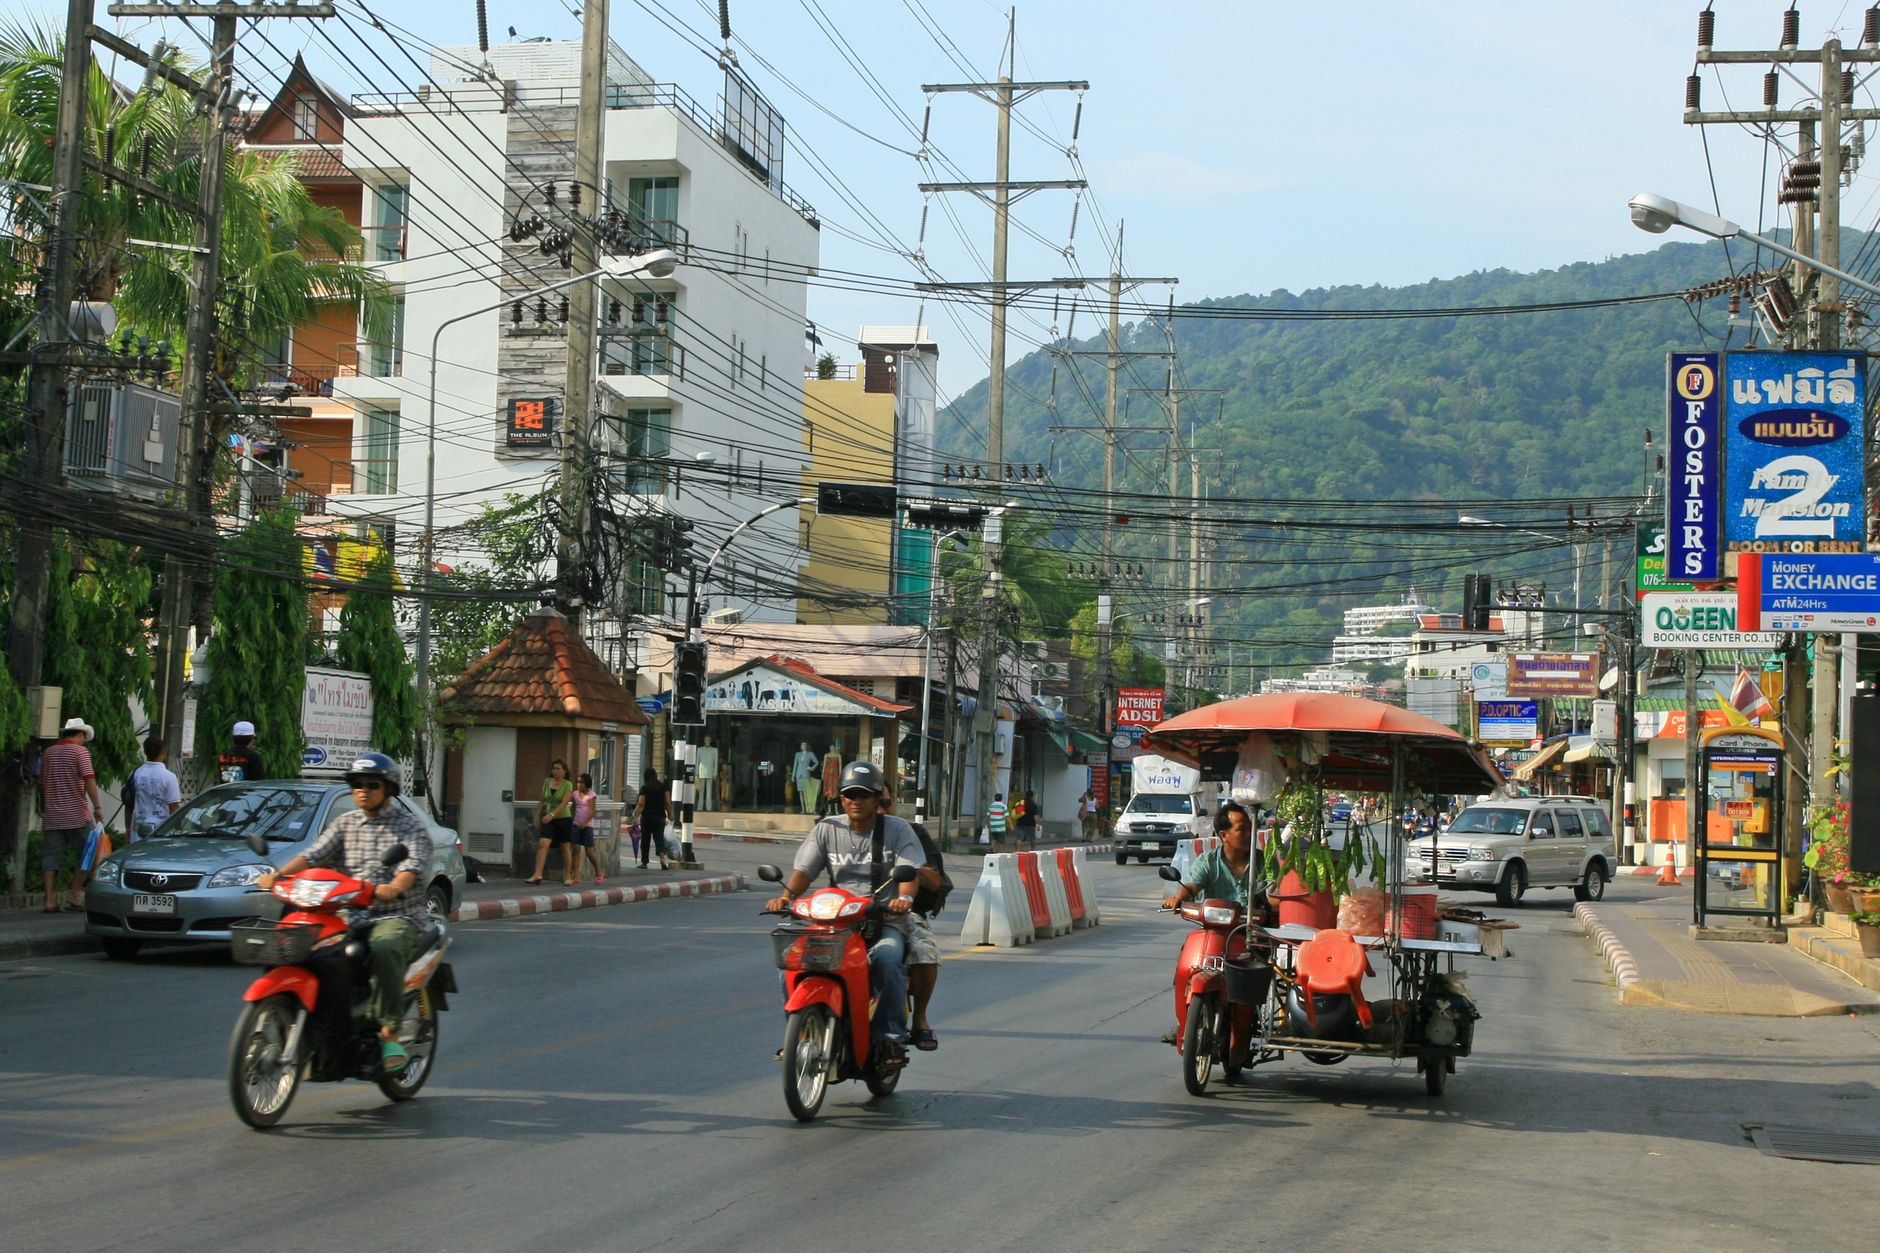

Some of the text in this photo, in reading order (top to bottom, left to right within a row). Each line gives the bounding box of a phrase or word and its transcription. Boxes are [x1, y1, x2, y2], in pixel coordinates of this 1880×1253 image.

[1733, 358, 1855, 404] แฟมิลี่
[1754, 412, 1835, 438] แมนชั่น
[1749, 468, 1840, 492] Famy
[1729, 541, 1860, 552] ROOM FOR RENT
[1772, 561, 1816, 573] MONEY
[1772, 574, 1877, 590] EXCHANGE
[1656, 606, 1736, 630] QUEEN
[1653, 633, 1699, 643] BOOKING
[1702, 633, 1741, 643] CENTER
[1118, 697, 1162, 710] INTERNET
[1118, 709, 1161, 722] ADSL
[151, 896, 173, 906] 3592
